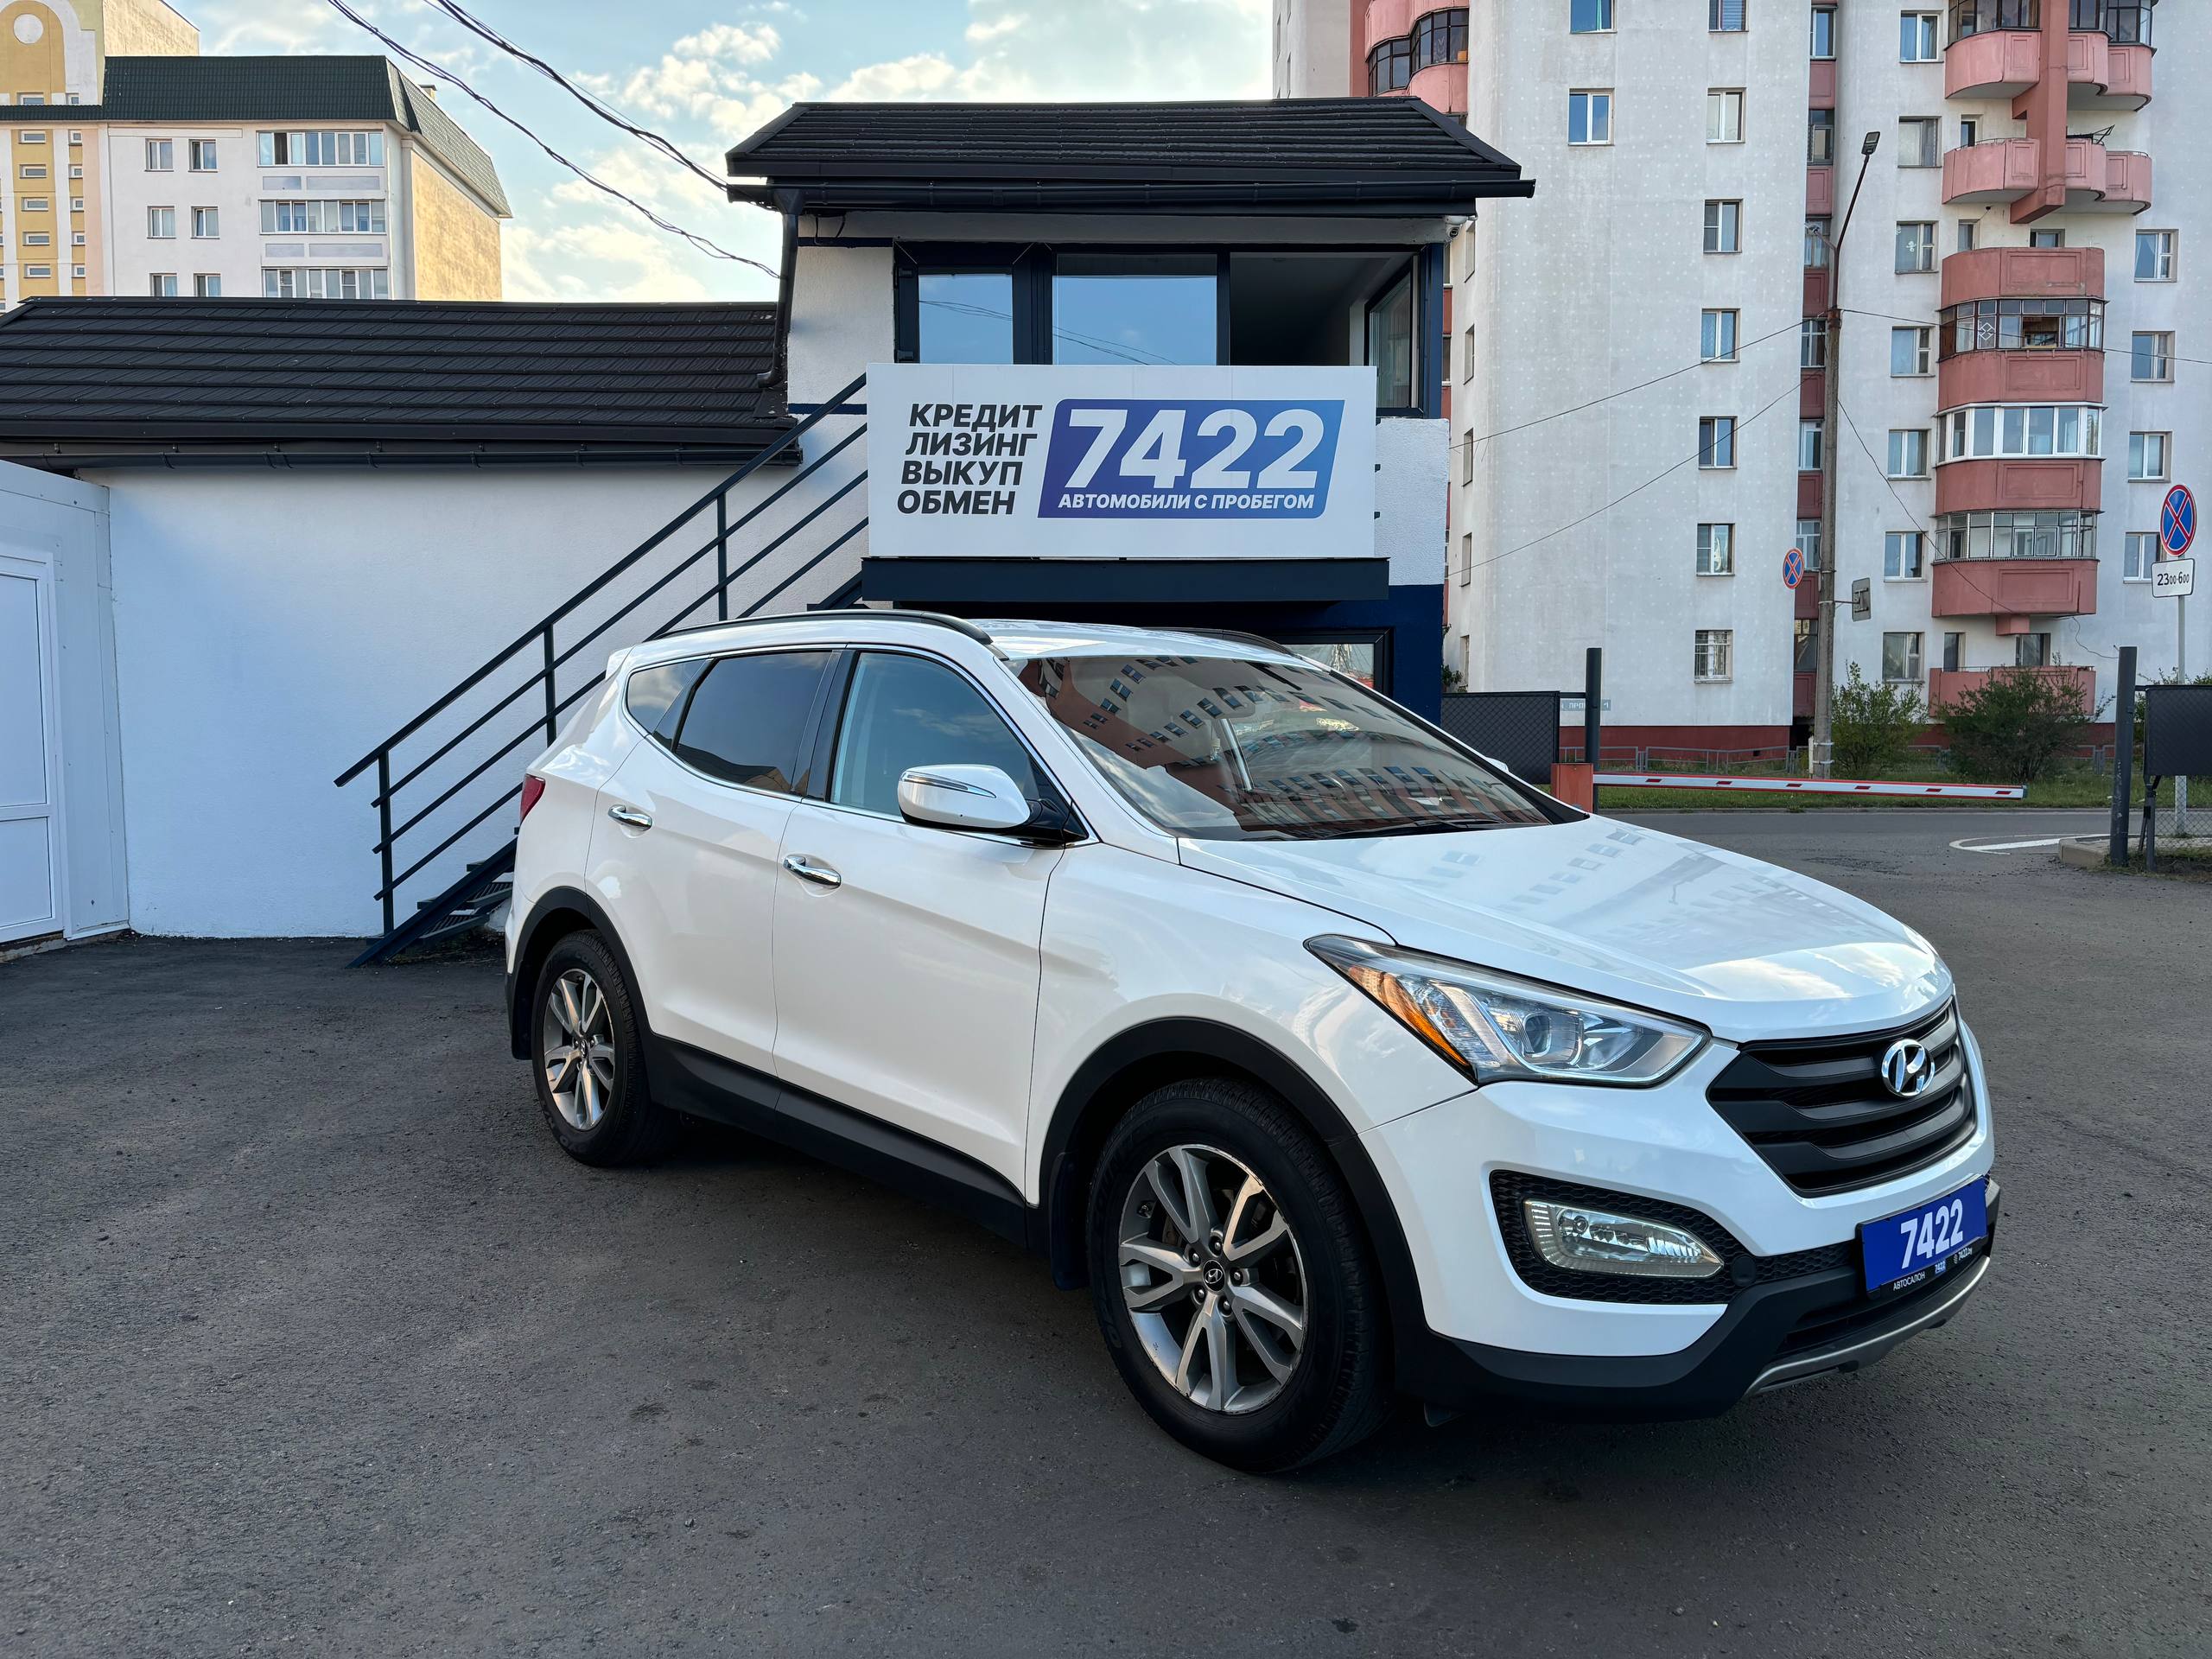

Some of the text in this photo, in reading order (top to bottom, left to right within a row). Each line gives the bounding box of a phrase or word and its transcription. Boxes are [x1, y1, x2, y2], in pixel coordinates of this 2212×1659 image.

[909, 404, 1042, 429] КРЕДИТ
[906, 433, 1037, 456] ЛИЗИНГ
[1065, 409, 1325, 489] 7422
[901, 461, 1023, 485] ВЫКУП
[897, 490, 1015, 514] ОБМЕН
[1058, 493, 1314, 510] АВТОМОБИЛИ С ПРОБЕГОМ
[1901, 1198, 1963, 1269] 7422
[1893, 1271, 1925, 1291] АВТОСАЛОН
